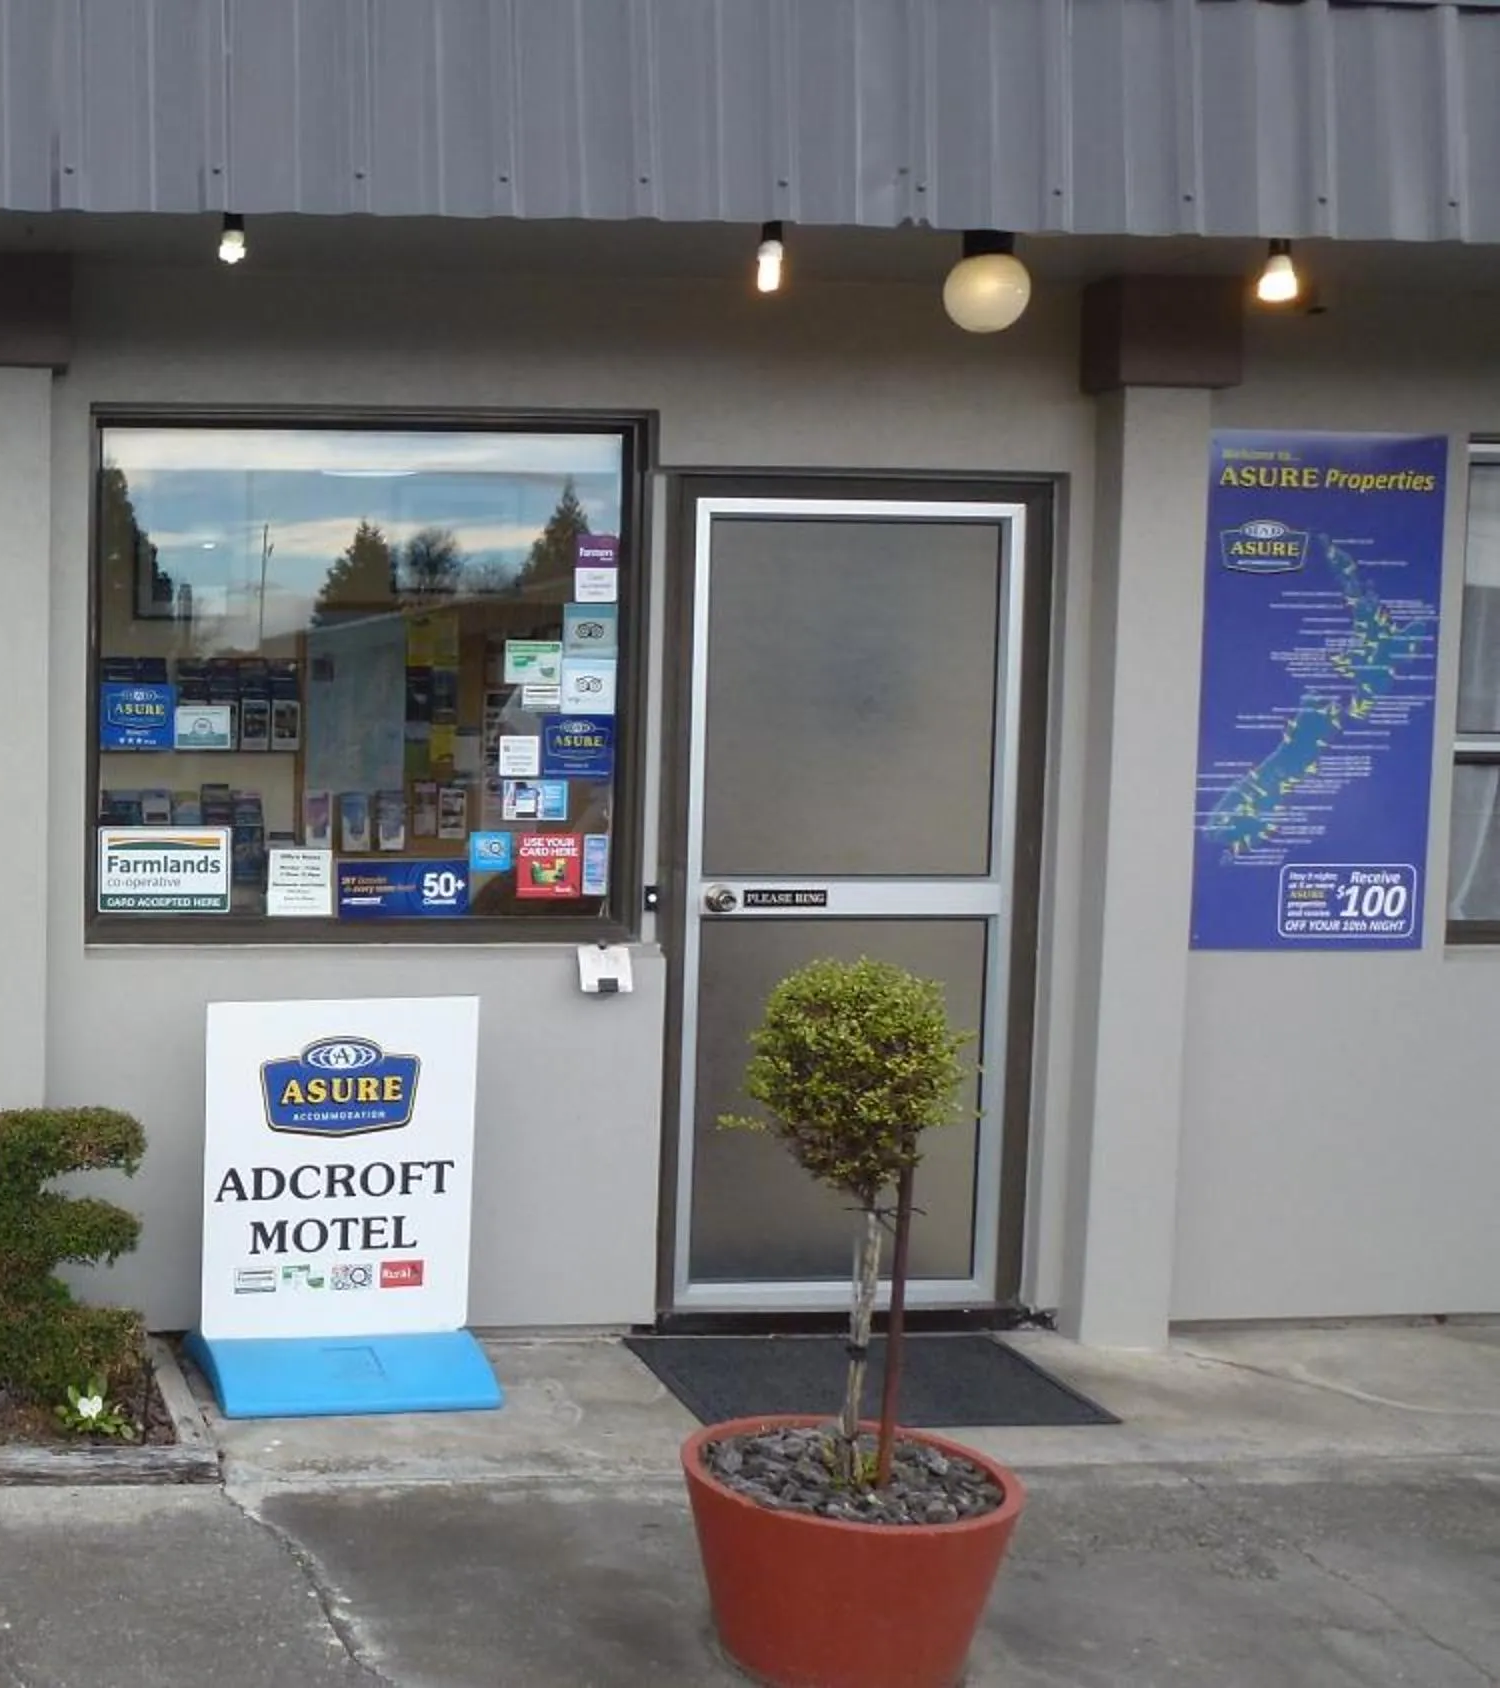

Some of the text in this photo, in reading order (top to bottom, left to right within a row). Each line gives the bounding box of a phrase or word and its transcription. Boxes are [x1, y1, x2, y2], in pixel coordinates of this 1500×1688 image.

[1219, 465, 1436, 493] ASURE Properties
[1229, 540, 1301, 557] ASURE
[114, 703, 166, 716] ASURE
[553, 734, 605, 748] ASURE
[523, 837, 575, 847] USE YOUR
[519, 847, 579, 857] CARD HERE
[107, 855, 221, 873] Farmlands
[107, 876, 181, 889] co-operative
[1349, 870, 1402, 884] Receive
[422, 871, 466, 898] 50+
[106, 897, 221, 907] CARD ACCEPTED HERE
[746, 892, 825, 904] PLEASE RING
[1336, 884, 1407, 918] $100
[1285, 920, 1306, 932] OFF
[1308, 920, 1341, 932] YOUR
[1369, 919, 1406, 932] NIGHT
[279, 1075, 404, 1105] ASURE
[292, 1109, 387, 1121] ACCOMMODATION
[214, 1159, 455, 1203] ADCROFT
[249, 1215, 418, 1255] MOTEL
[382, 1267, 411, 1280] Rural
